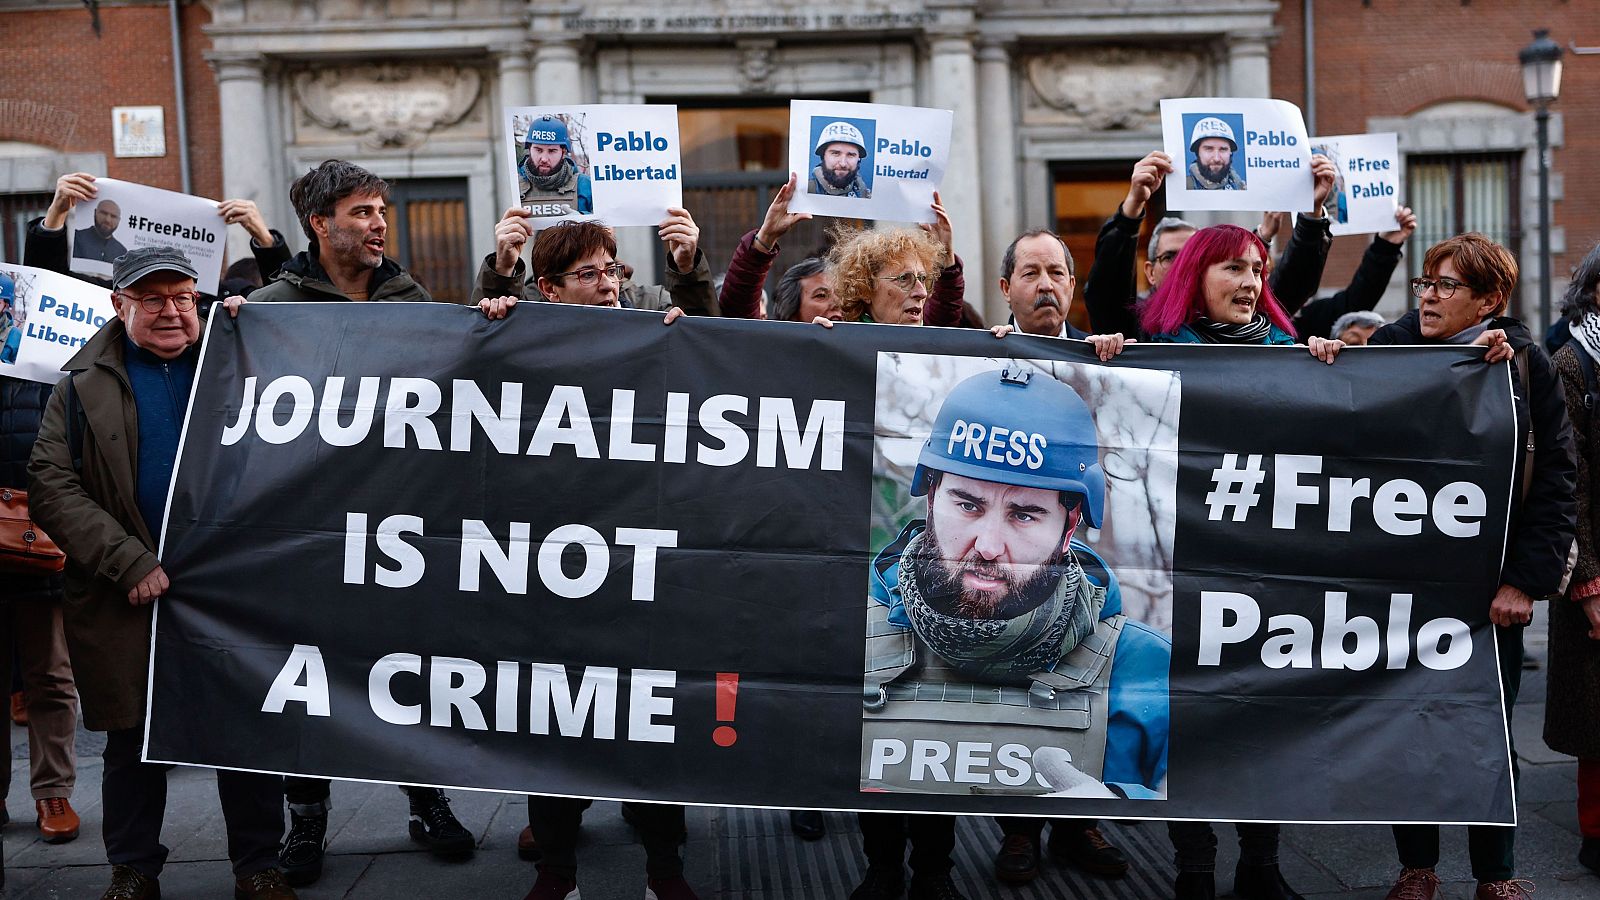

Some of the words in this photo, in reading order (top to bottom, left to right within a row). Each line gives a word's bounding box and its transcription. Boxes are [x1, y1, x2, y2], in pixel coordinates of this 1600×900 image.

[531, 130, 556, 141] PRESS
[596, 131, 668, 152] Pablo
[1246, 130, 1297, 147] Pablo
[877, 138, 932, 157] Pablo
[594, 164, 677, 181] Libertad
[876, 165, 929, 179] Libertad
[1247, 157, 1300, 169] Libertad
[1349, 157, 1390, 172] #Free
[1352, 181, 1394, 199] Pablo
[128, 214, 216, 244] #FreePablo
[39, 295, 107, 329] Pablo
[27, 322, 88, 348] Libert
[221, 375, 846, 471] JOURNALISM
[947, 419, 1047, 470] PRESS
[1204, 453, 1487, 538] #Free
[343, 511, 426, 588] IS
[459, 519, 678, 601] NOT
[1197, 591, 1473, 671] Pablo
[261, 644, 331, 717] A
[368, 652, 677, 744] CRIME
